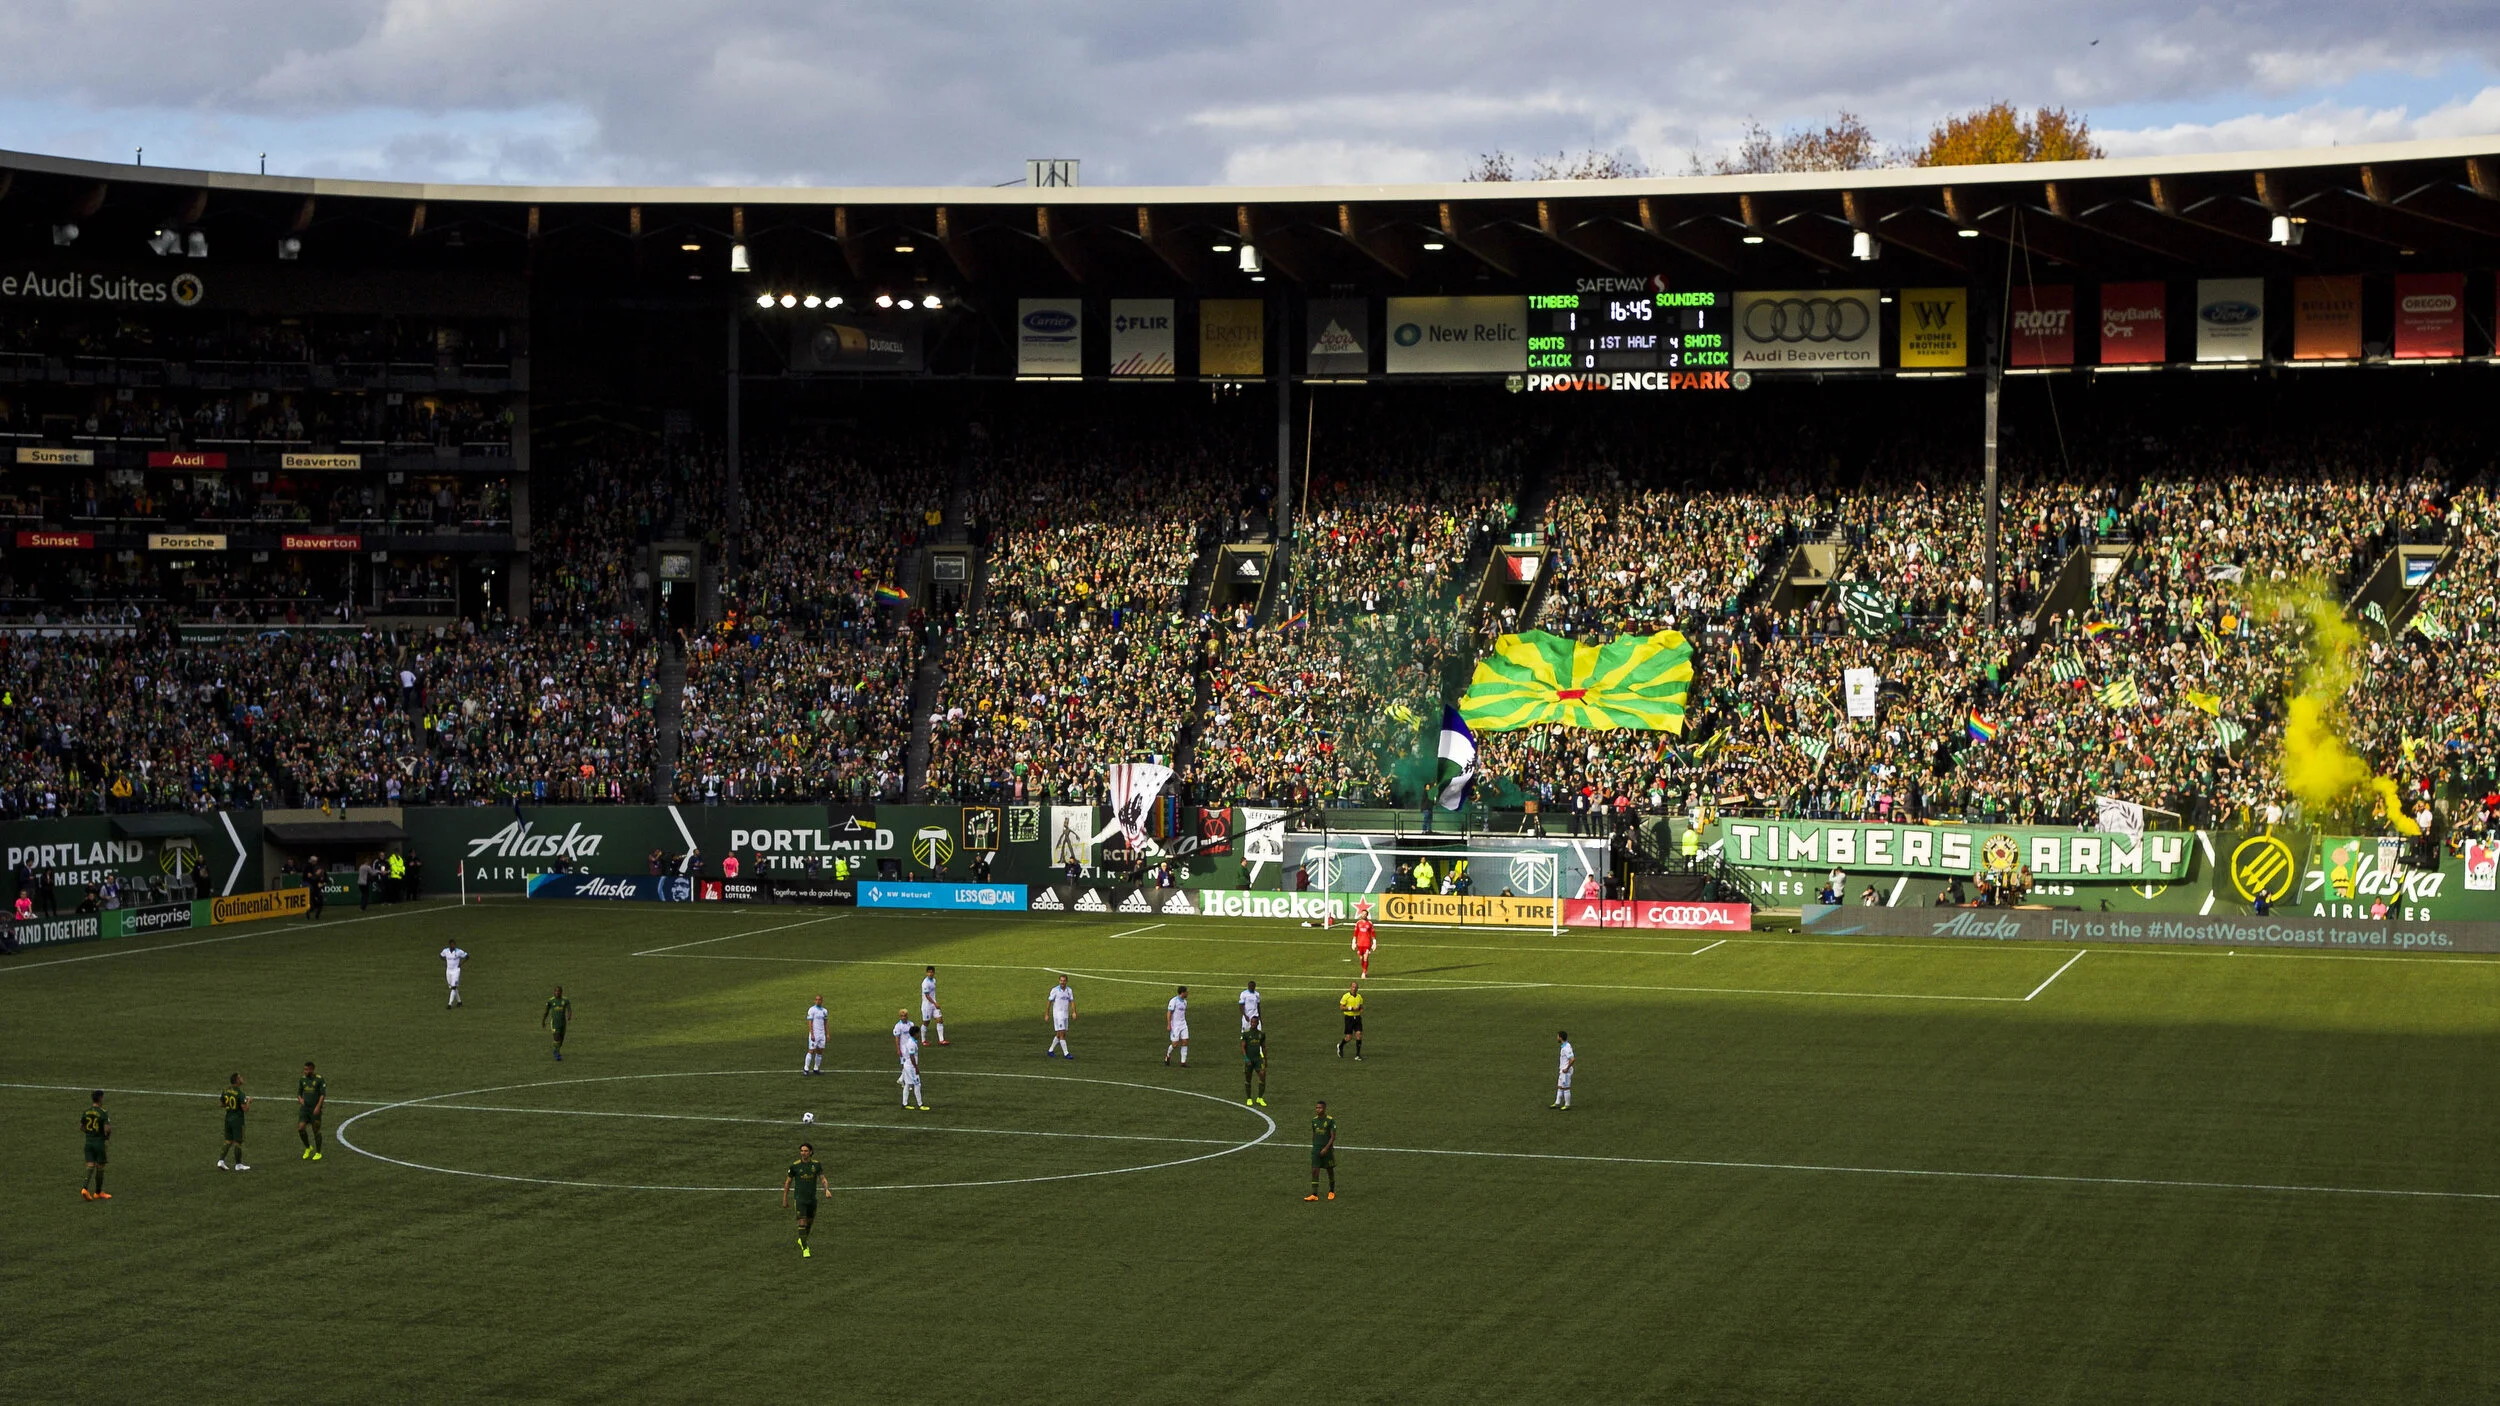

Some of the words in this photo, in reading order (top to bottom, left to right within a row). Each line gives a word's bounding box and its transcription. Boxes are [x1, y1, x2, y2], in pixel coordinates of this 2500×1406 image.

[22, 271, 83, 298] Audi
[89, 274, 168, 302] Suites
[1576, 277, 1647, 292] SAFEWAY
[1528, 294, 1580, 309] TIMBERS
[1655, 292, 1715, 307] SOUNDERS
[2405, 299, 2451, 309] OREGON
[1610, 299, 1652, 321] 16:45
[2102, 307, 2163, 323] KeyBank
[1029, 315, 1072, 327] Carrier
[1129, 316, 1168, 329] FLIR
[1570, 312, 1576, 331] 1
[1698, 310, 1704, 329] 1
[2014, 309, 2072, 329] ROOT
[1429, 325, 1468, 342] New
[1474, 323, 1517, 341] Relic
[1915, 333, 1952, 341] WIDMER
[1528, 336, 1565, 351] SHOTS
[1589, 338, 1595, 350] 1
[1600, 335, 1622, 349] 1ST
[1627, 335, 1658, 349] HALF
[1669, 337, 1679, 349] 4
[1684, 334, 1722, 349] SHOTS
[1909, 341, 1957, 350] BROTHERS
[1585, 354, 1595, 368] 0
[1669, 353, 1679, 367] 2
[1743, 350, 1781, 362] Audi
[1787, 349, 1871, 361] Beaverton
[32, 450, 79, 463] Sunset
[171, 454, 205, 466] Audi
[286, 452, 356, 467] Beaverton
[31, 534, 80, 546] Sunset
[161, 536, 215, 548] Porsche
[286, 536, 358, 549] Beaverton
[467, 820, 603, 862] Alaska
[1731, 824, 1973, 869] TIMBERS
[8, 839, 144, 871] PORTLAND
[2030, 836, 2183, 874] ARMY
[575, 877, 637, 899] Alaska
[724, 884, 758, 893] OREGON
[773, 888, 798, 898] Together,
[798, 890, 808, 898] we
[809, 888, 817, 897] do
[817, 888, 833, 899] good
[955, 889, 979, 903] LESS
[980, 891, 995, 902] WE
[996, 889, 1015, 904] CAN
[213, 893, 273, 923] Continental
[284, 894, 306, 909] TIRE
[1031, 901, 1065, 911] adidas
[1073, 902, 1107, 913] adidas
[1119, 902, 1153, 914] adidas
[1161, 903, 1195, 915] adidas
[1202, 889, 1346, 920] Heineken
[1386, 896, 1492, 919] Continental
[1514, 904, 1554, 919] TIRE
[124, 907, 191, 929] enterprise
[1581, 904, 1632, 922] Audi
[14, 922, 42, 945] TAND
[43, 917, 98, 941] TOGETHER
[1931, 911, 2023, 941] Alaska
[2051, 919, 2081, 940] Fly
[2084, 922, 2105, 937] to
[2110, 920, 2142, 937] the
[2147, 920, 2325, 943] #MostWestCoast
[2329, 928, 2387, 945] travel
[2393, 929, 2454, 948] spots.
[224, 1095, 237, 1110] 20
[85, 1117, 100, 1132] 24
